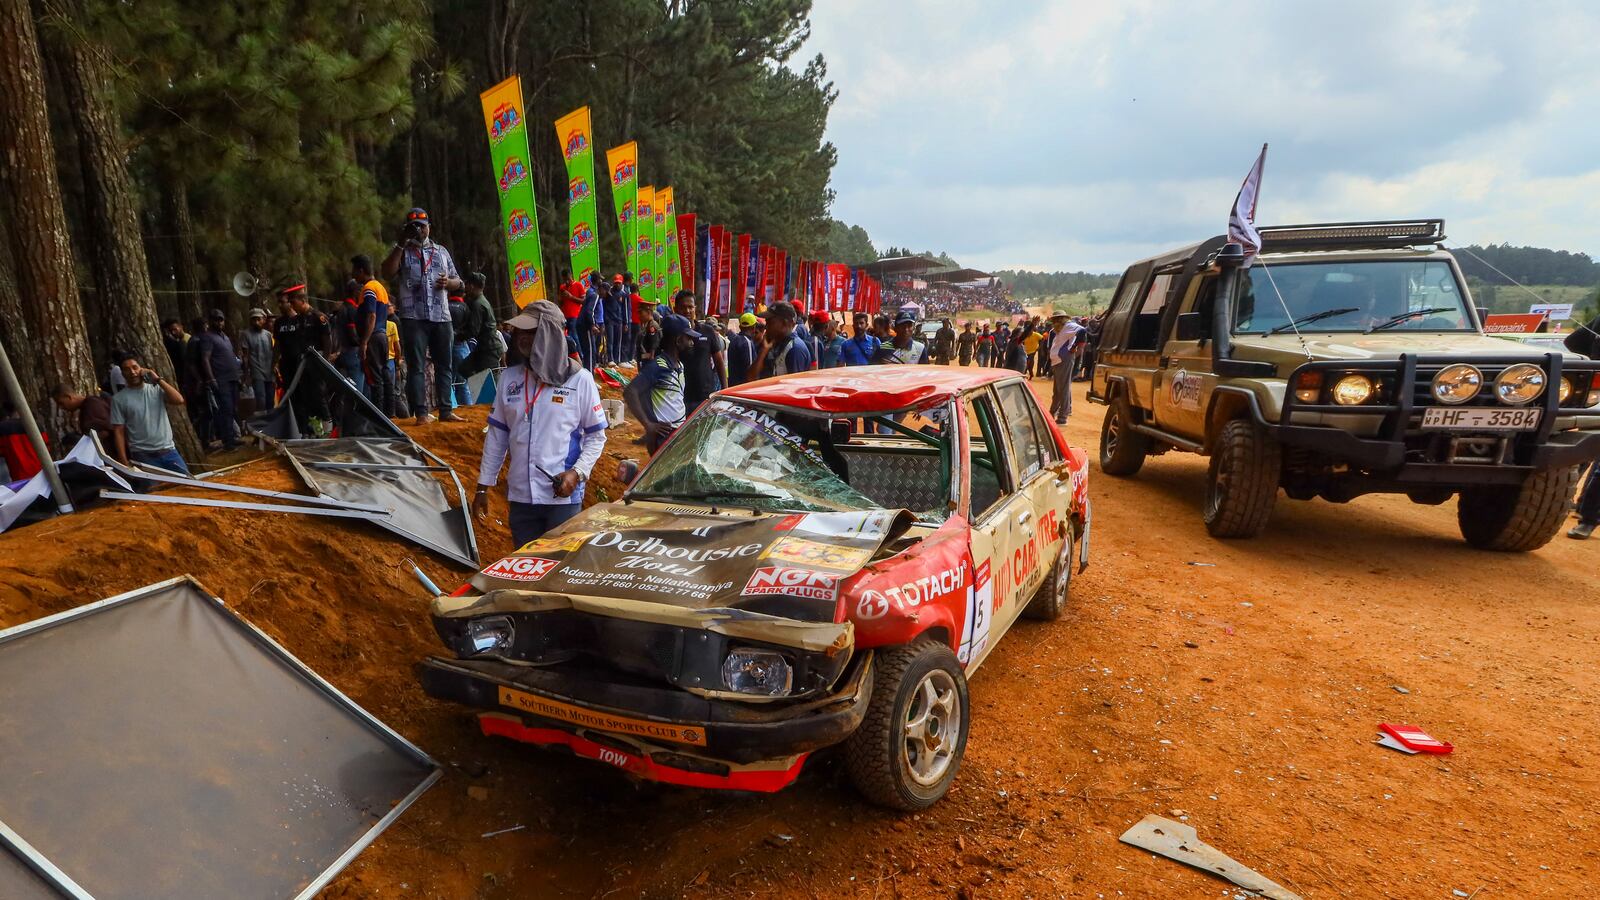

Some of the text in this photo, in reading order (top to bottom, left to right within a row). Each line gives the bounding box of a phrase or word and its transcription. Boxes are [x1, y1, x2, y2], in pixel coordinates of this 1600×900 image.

[680, 229, 690, 277] asianpaints
[1484, 322, 1528, 332] asianpaints
[1442, 411, 1468, 425] HF
[1487, 411, 1535, 426] 3584
[764, 427, 791, 446] Tuned
[588, 531, 762, 562] Delhousie
[487, 570, 513, 578] SPARK
[496, 558, 553, 574] NGK
[559, 566, 594, 578] Adam
[603, 572, 636, 580] peak
[614, 555, 706, 577] Hotel
[746, 567, 837, 589] NGK
[885, 565, 965, 609] TOTACHI
[612, 580, 632, 589] 660
[638, 583, 657, 591] 052
[659, 585, 674, 594] 22
[675, 588, 689, 596] 77
[691, 591, 711, 600] 661
[744, 587, 833, 600] SPARK PLUGS
[976, 600, 983, 628] 5
[520, 697, 677, 738] SOUTHERN MOTOR SPORTS CLUB
[598, 748, 628, 766] TOW
